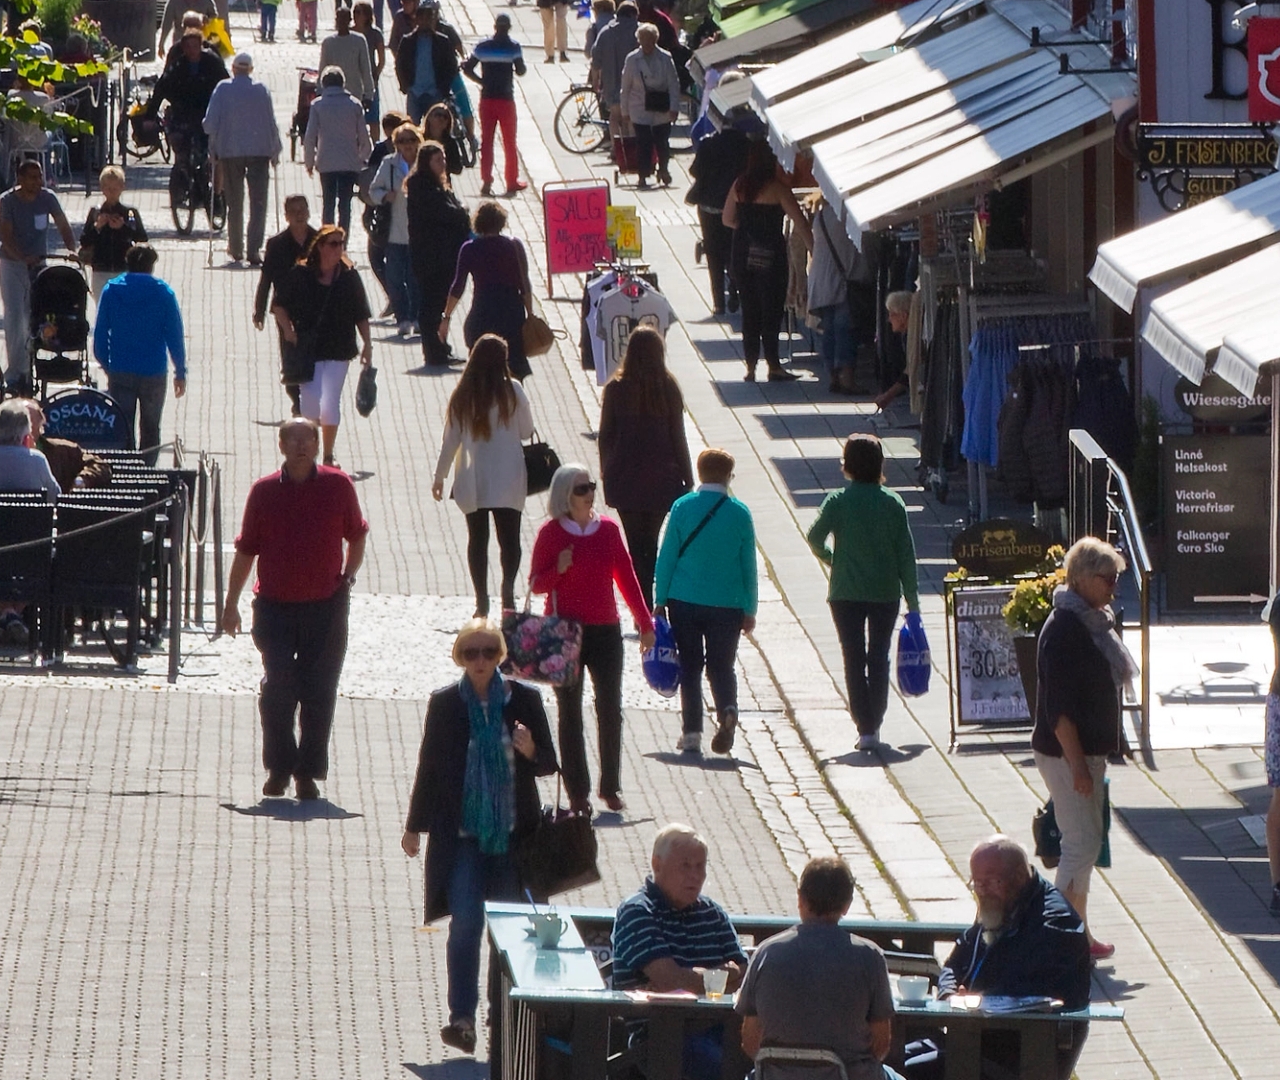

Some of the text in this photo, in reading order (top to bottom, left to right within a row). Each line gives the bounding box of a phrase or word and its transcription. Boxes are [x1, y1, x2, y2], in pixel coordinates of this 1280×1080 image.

[1148, 140, 1278, 165] J. FRISENBERG
[552, 192, 601, 223] SALG
[47, 403, 117, 428] OSCANA
[1174, 448, 1204, 460] Linné
[1174, 462, 1228, 473] Helsekost
[1175, 489, 1216, 500] Victoria
[1176, 502, 1235, 514] Herrefrisør
[1176, 529, 1231, 543] Falkanger
[1177, 543, 1225, 554] Euro Sko
